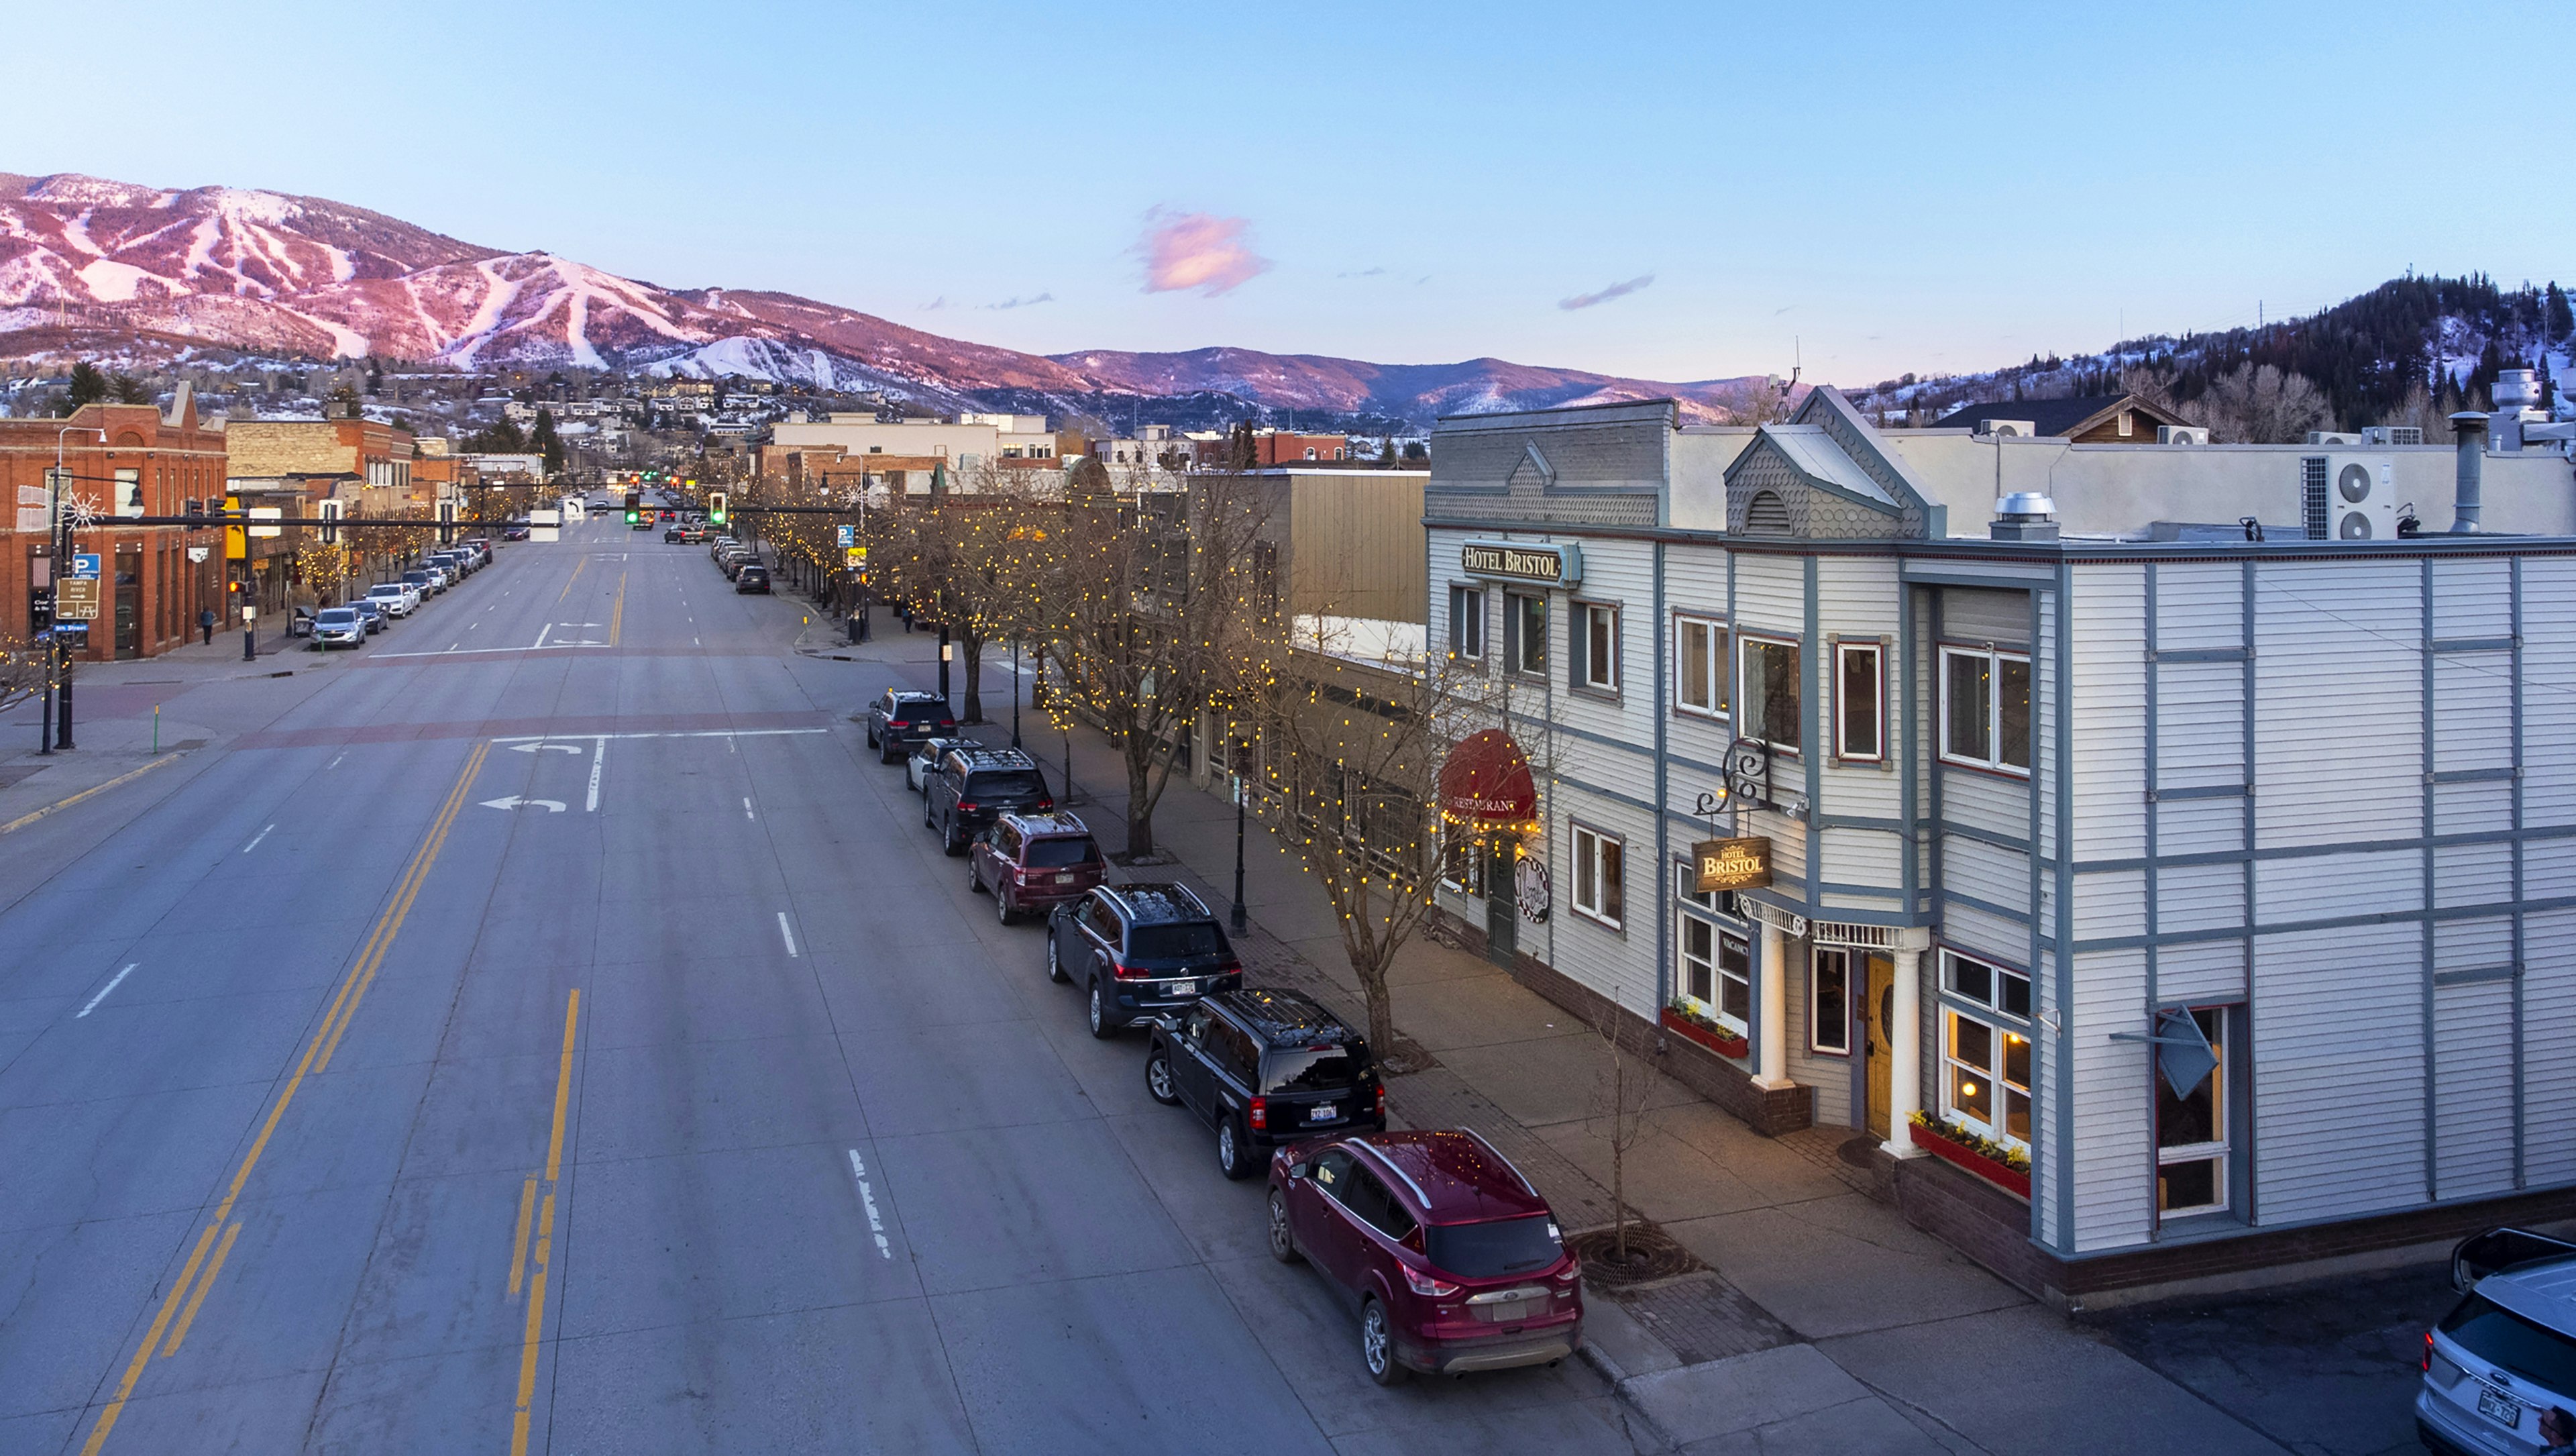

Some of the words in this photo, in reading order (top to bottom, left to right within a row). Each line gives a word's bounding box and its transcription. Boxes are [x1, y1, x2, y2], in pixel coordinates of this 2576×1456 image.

[74, 559, 89, 574] P
[1465, 547, 1503, 570] HOTEL
[1505, 550, 1558, 576] BRISTOL
[1454, 796, 1517, 812] RESTAURANT
[1721, 850, 1746, 859] HOTEL
[1703, 857, 1763, 875] BRISTOL
